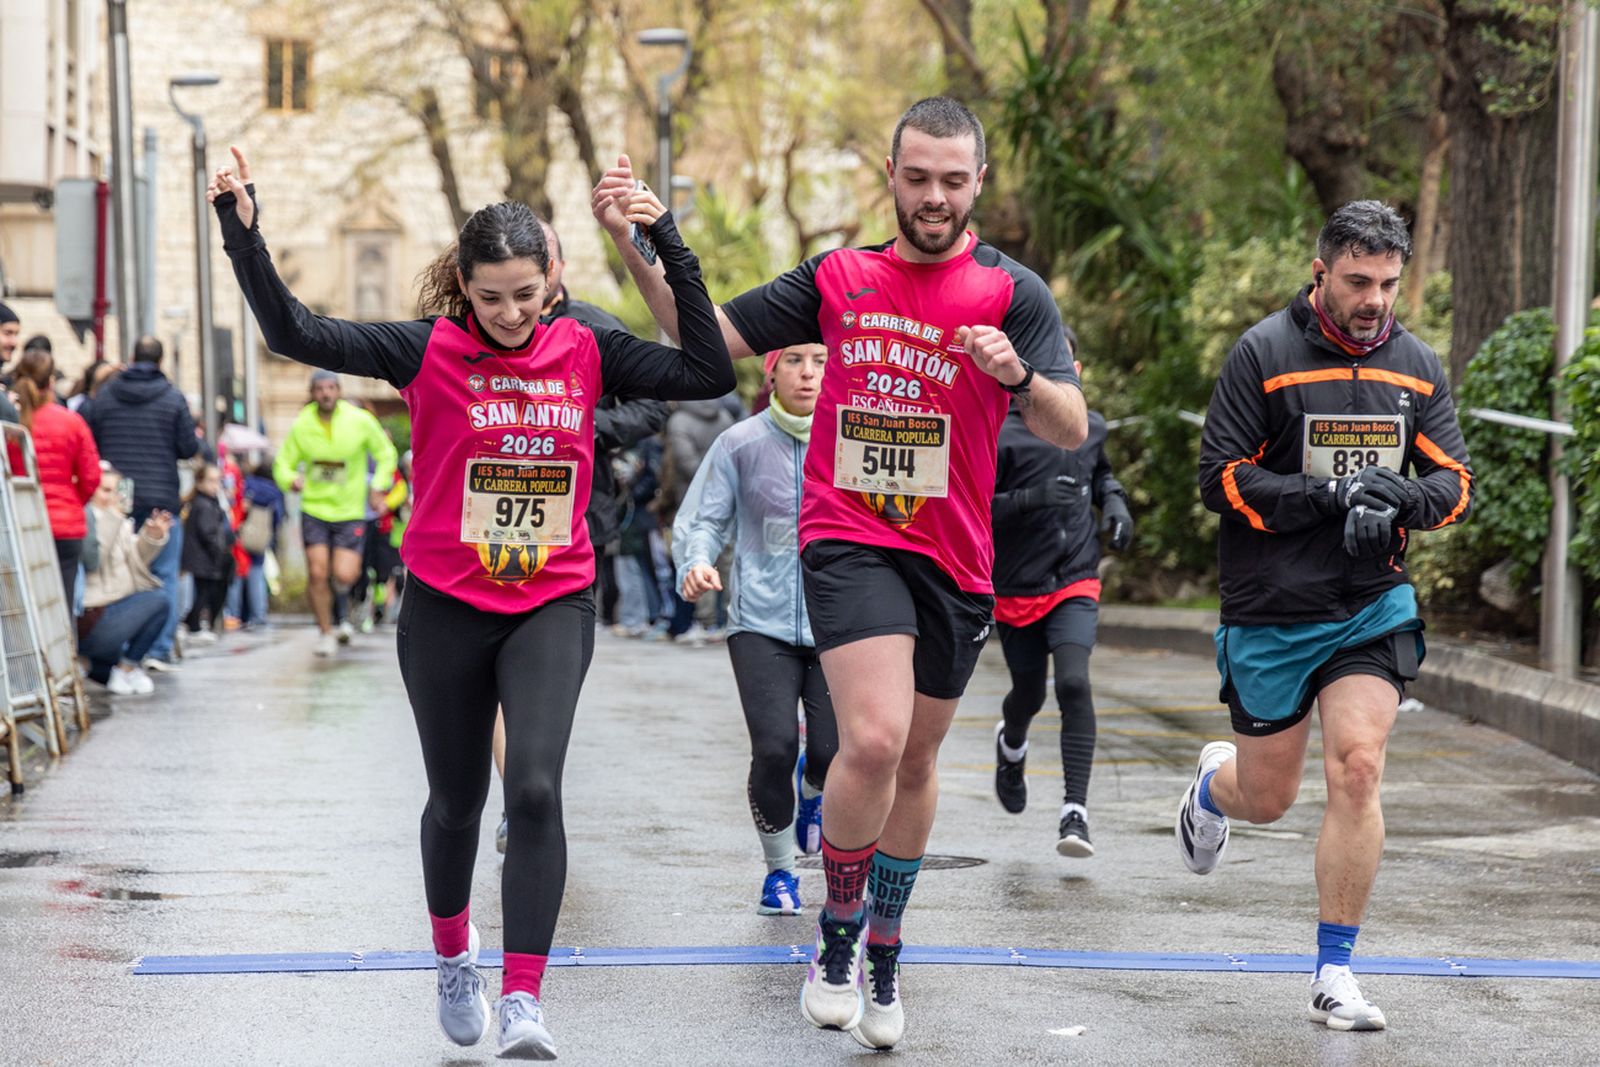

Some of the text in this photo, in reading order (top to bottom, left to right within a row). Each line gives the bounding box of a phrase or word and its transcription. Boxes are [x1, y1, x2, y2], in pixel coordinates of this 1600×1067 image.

[860, 314, 920, 336] CARRERA
[922, 325, 941, 343] DE
[841, 339, 959, 386] SAN ANTÓN
[547, 381, 564, 395] DE
[866, 371, 921, 400] 2026
[471, 401, 583, 432] SAN ANTÓN
[847, 412, 938, 430] IES San Juan Bosco
[1315, 422, 1395, 433] IES San Juan Bosco
[500, 433, 555, 456] 2026
[844, 424, 940, 445] V CARRERA POPULAR
[1312, 433, 1398, 446] V CARRERA POPULAR
[477, 465, 566, 479] IES San Juan Bosco
[862, 445, 915, 478] 544
[1333, 449, 1379, 477] 838
[474, 478, 567, 493] V CARRERA POPULAR
[495, 496, 546, 528] 975
